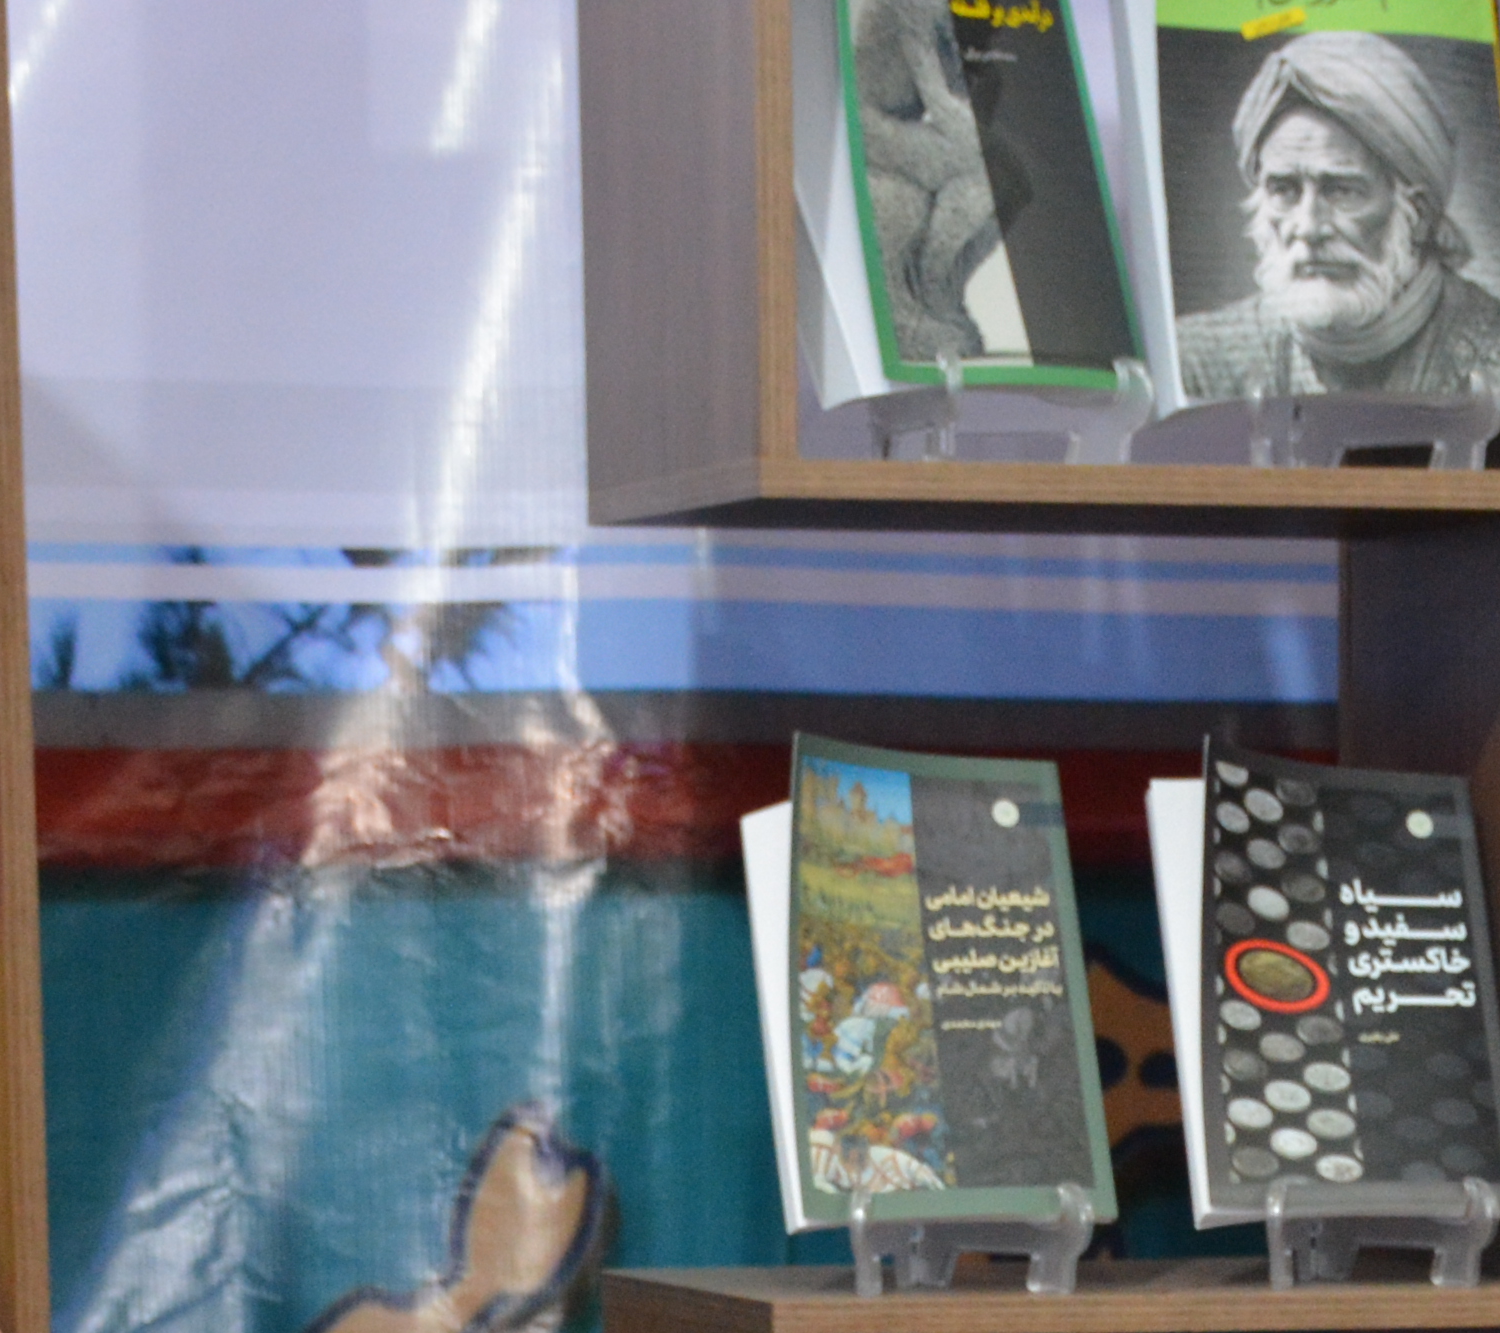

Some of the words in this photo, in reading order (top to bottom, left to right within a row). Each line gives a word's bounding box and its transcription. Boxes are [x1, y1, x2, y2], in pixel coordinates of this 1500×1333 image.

[924, 885, 975, 911] امامی
[976, 886, 1050, 912] شیعیان
[1340, 878, 1463, 913] سیاه
[1031, 921, 1054, 943] در
[1344, 920, 1361, 946] و
[1361, 913, 1468, 947] سفید
[932, 948, 997, 974] صلیبی
[998, 945, 1060, 974] آغازین
[1348, 946, 1471, 980] خاکستری
[1352, 980, 1477, 1015] تحریم
